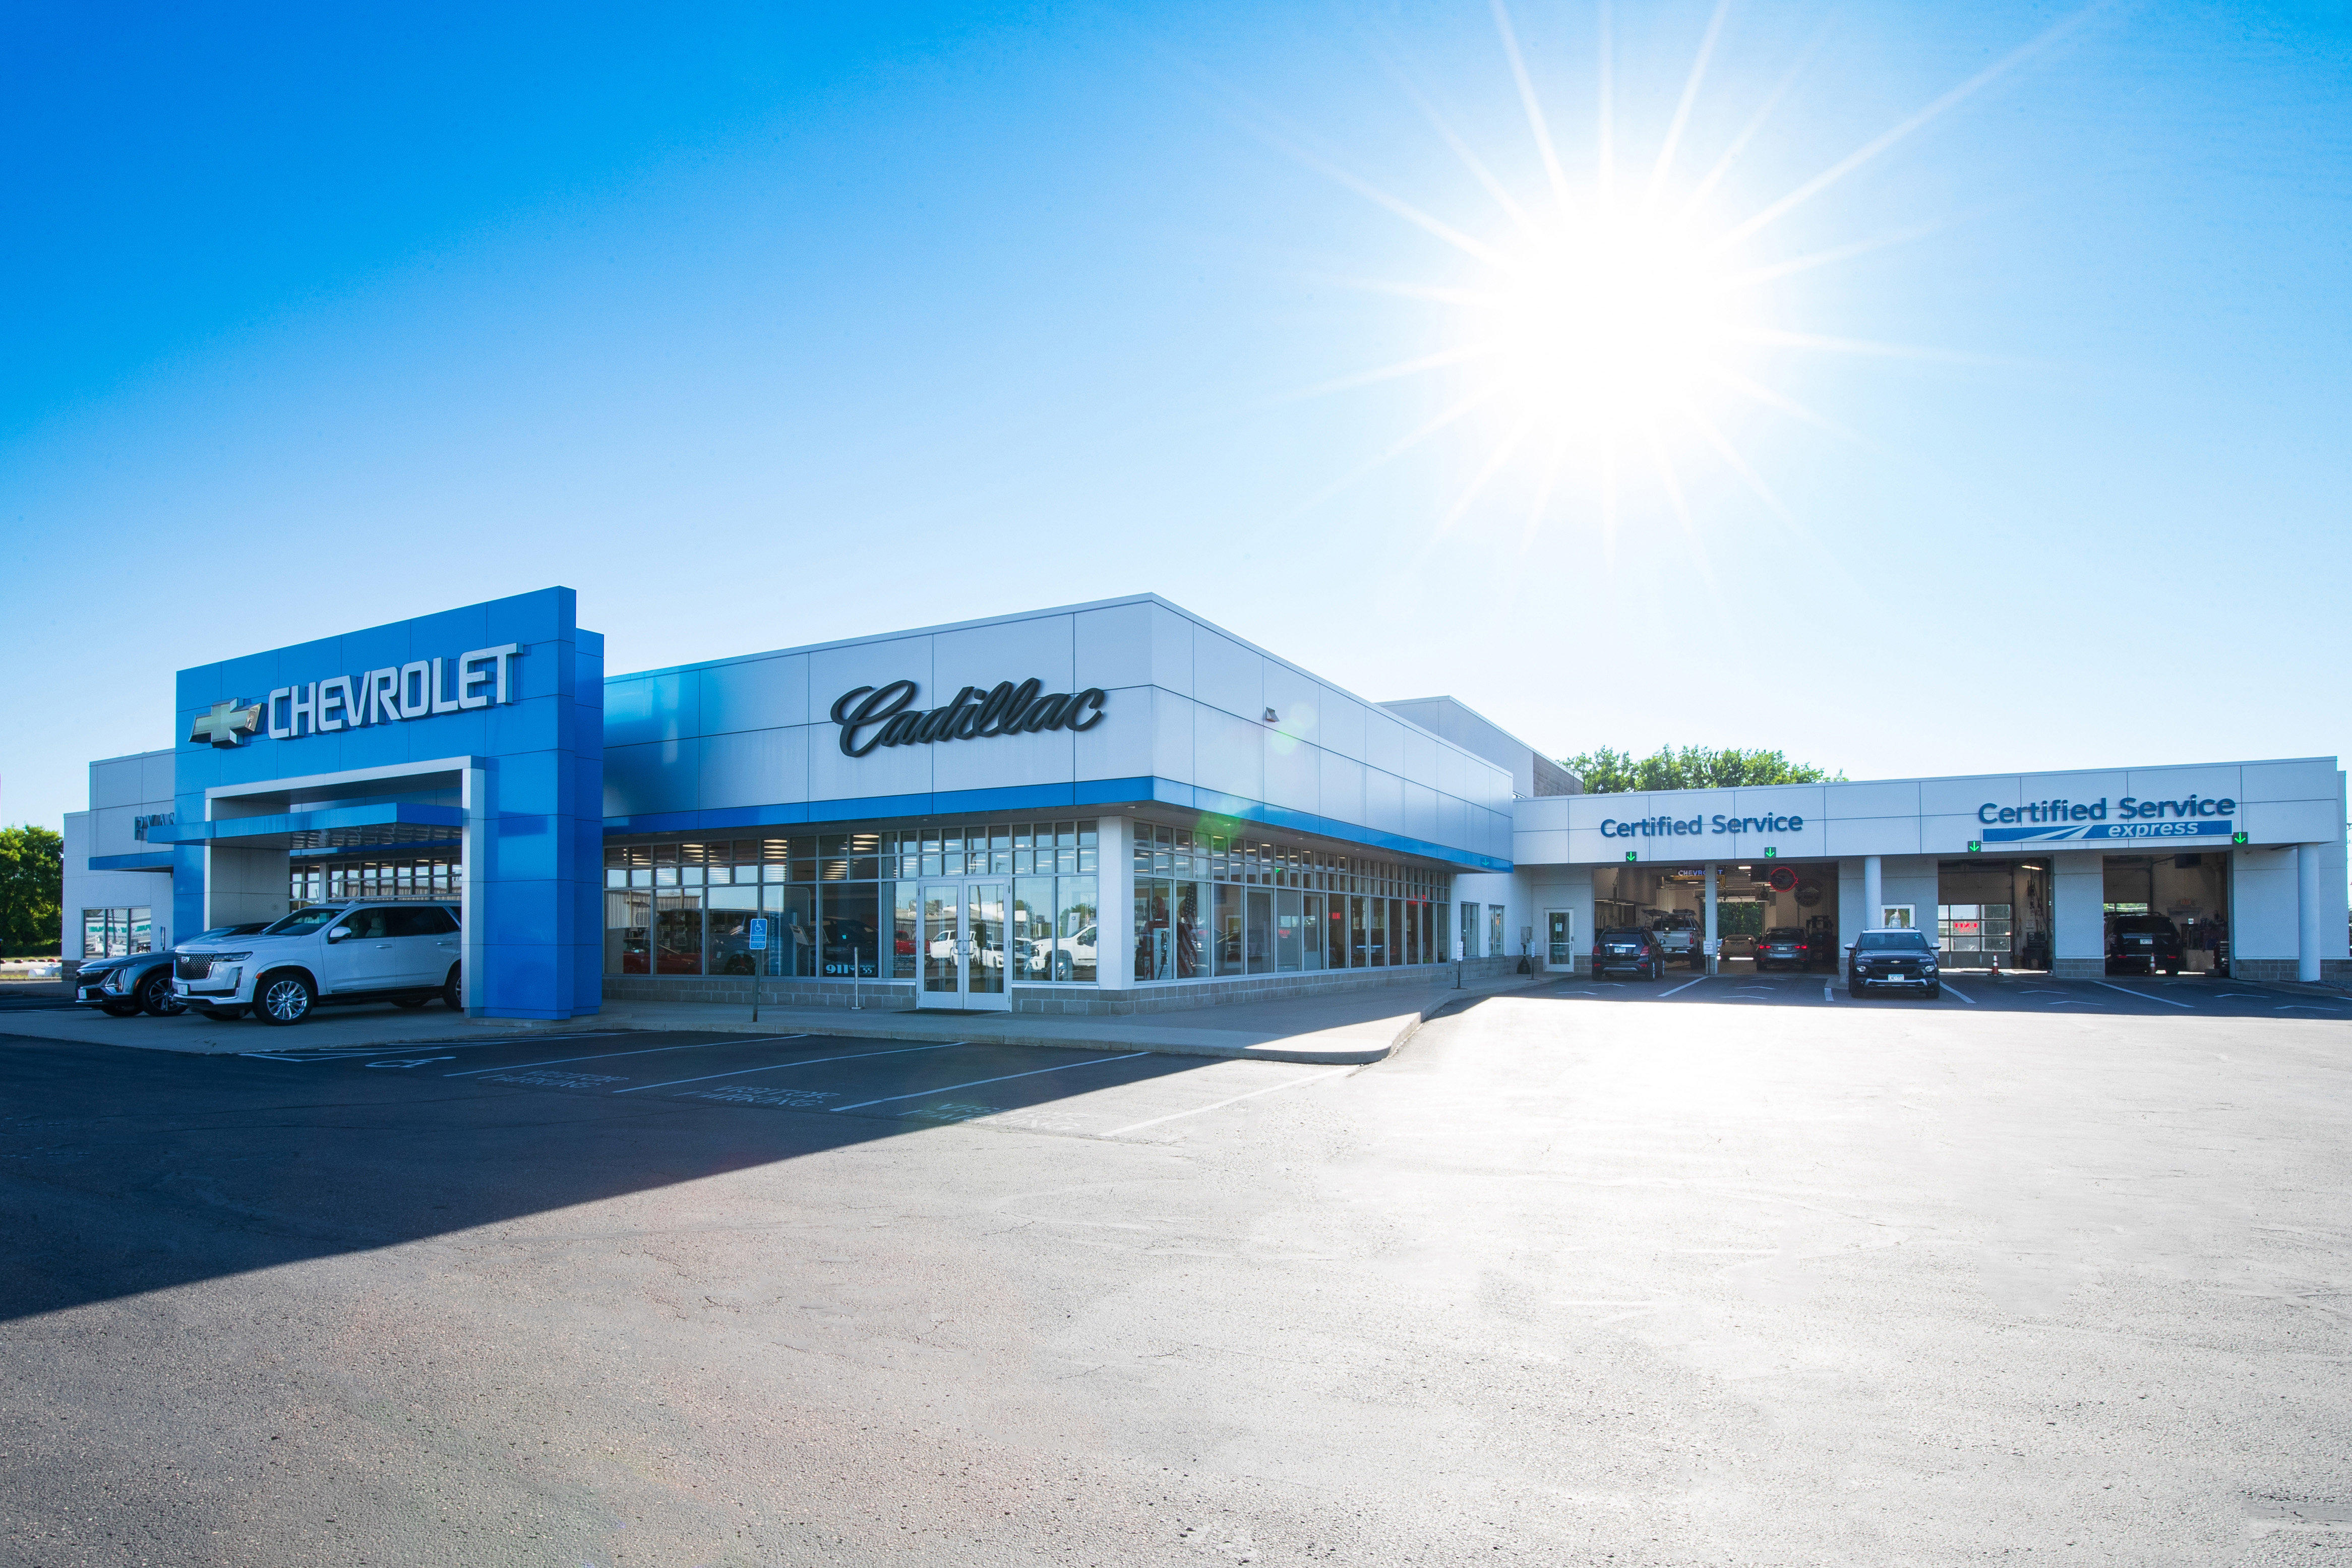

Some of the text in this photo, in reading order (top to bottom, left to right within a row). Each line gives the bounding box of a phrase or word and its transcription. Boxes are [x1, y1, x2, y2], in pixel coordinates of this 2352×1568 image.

[268, 642, 524, 739] CHEVROLET
[830, 677, 1105, 757] Cadillac
[1978, 794, 2236, 824] Certified Service
[1600, 812, 1803, 838] Certified Service
[2108, 823, 2199, 837] express
[825, 964, 849, 974] 911
[673, 1091, 824, 1107] PARKING
[712, 1085, 840, 1099] VISITOR
